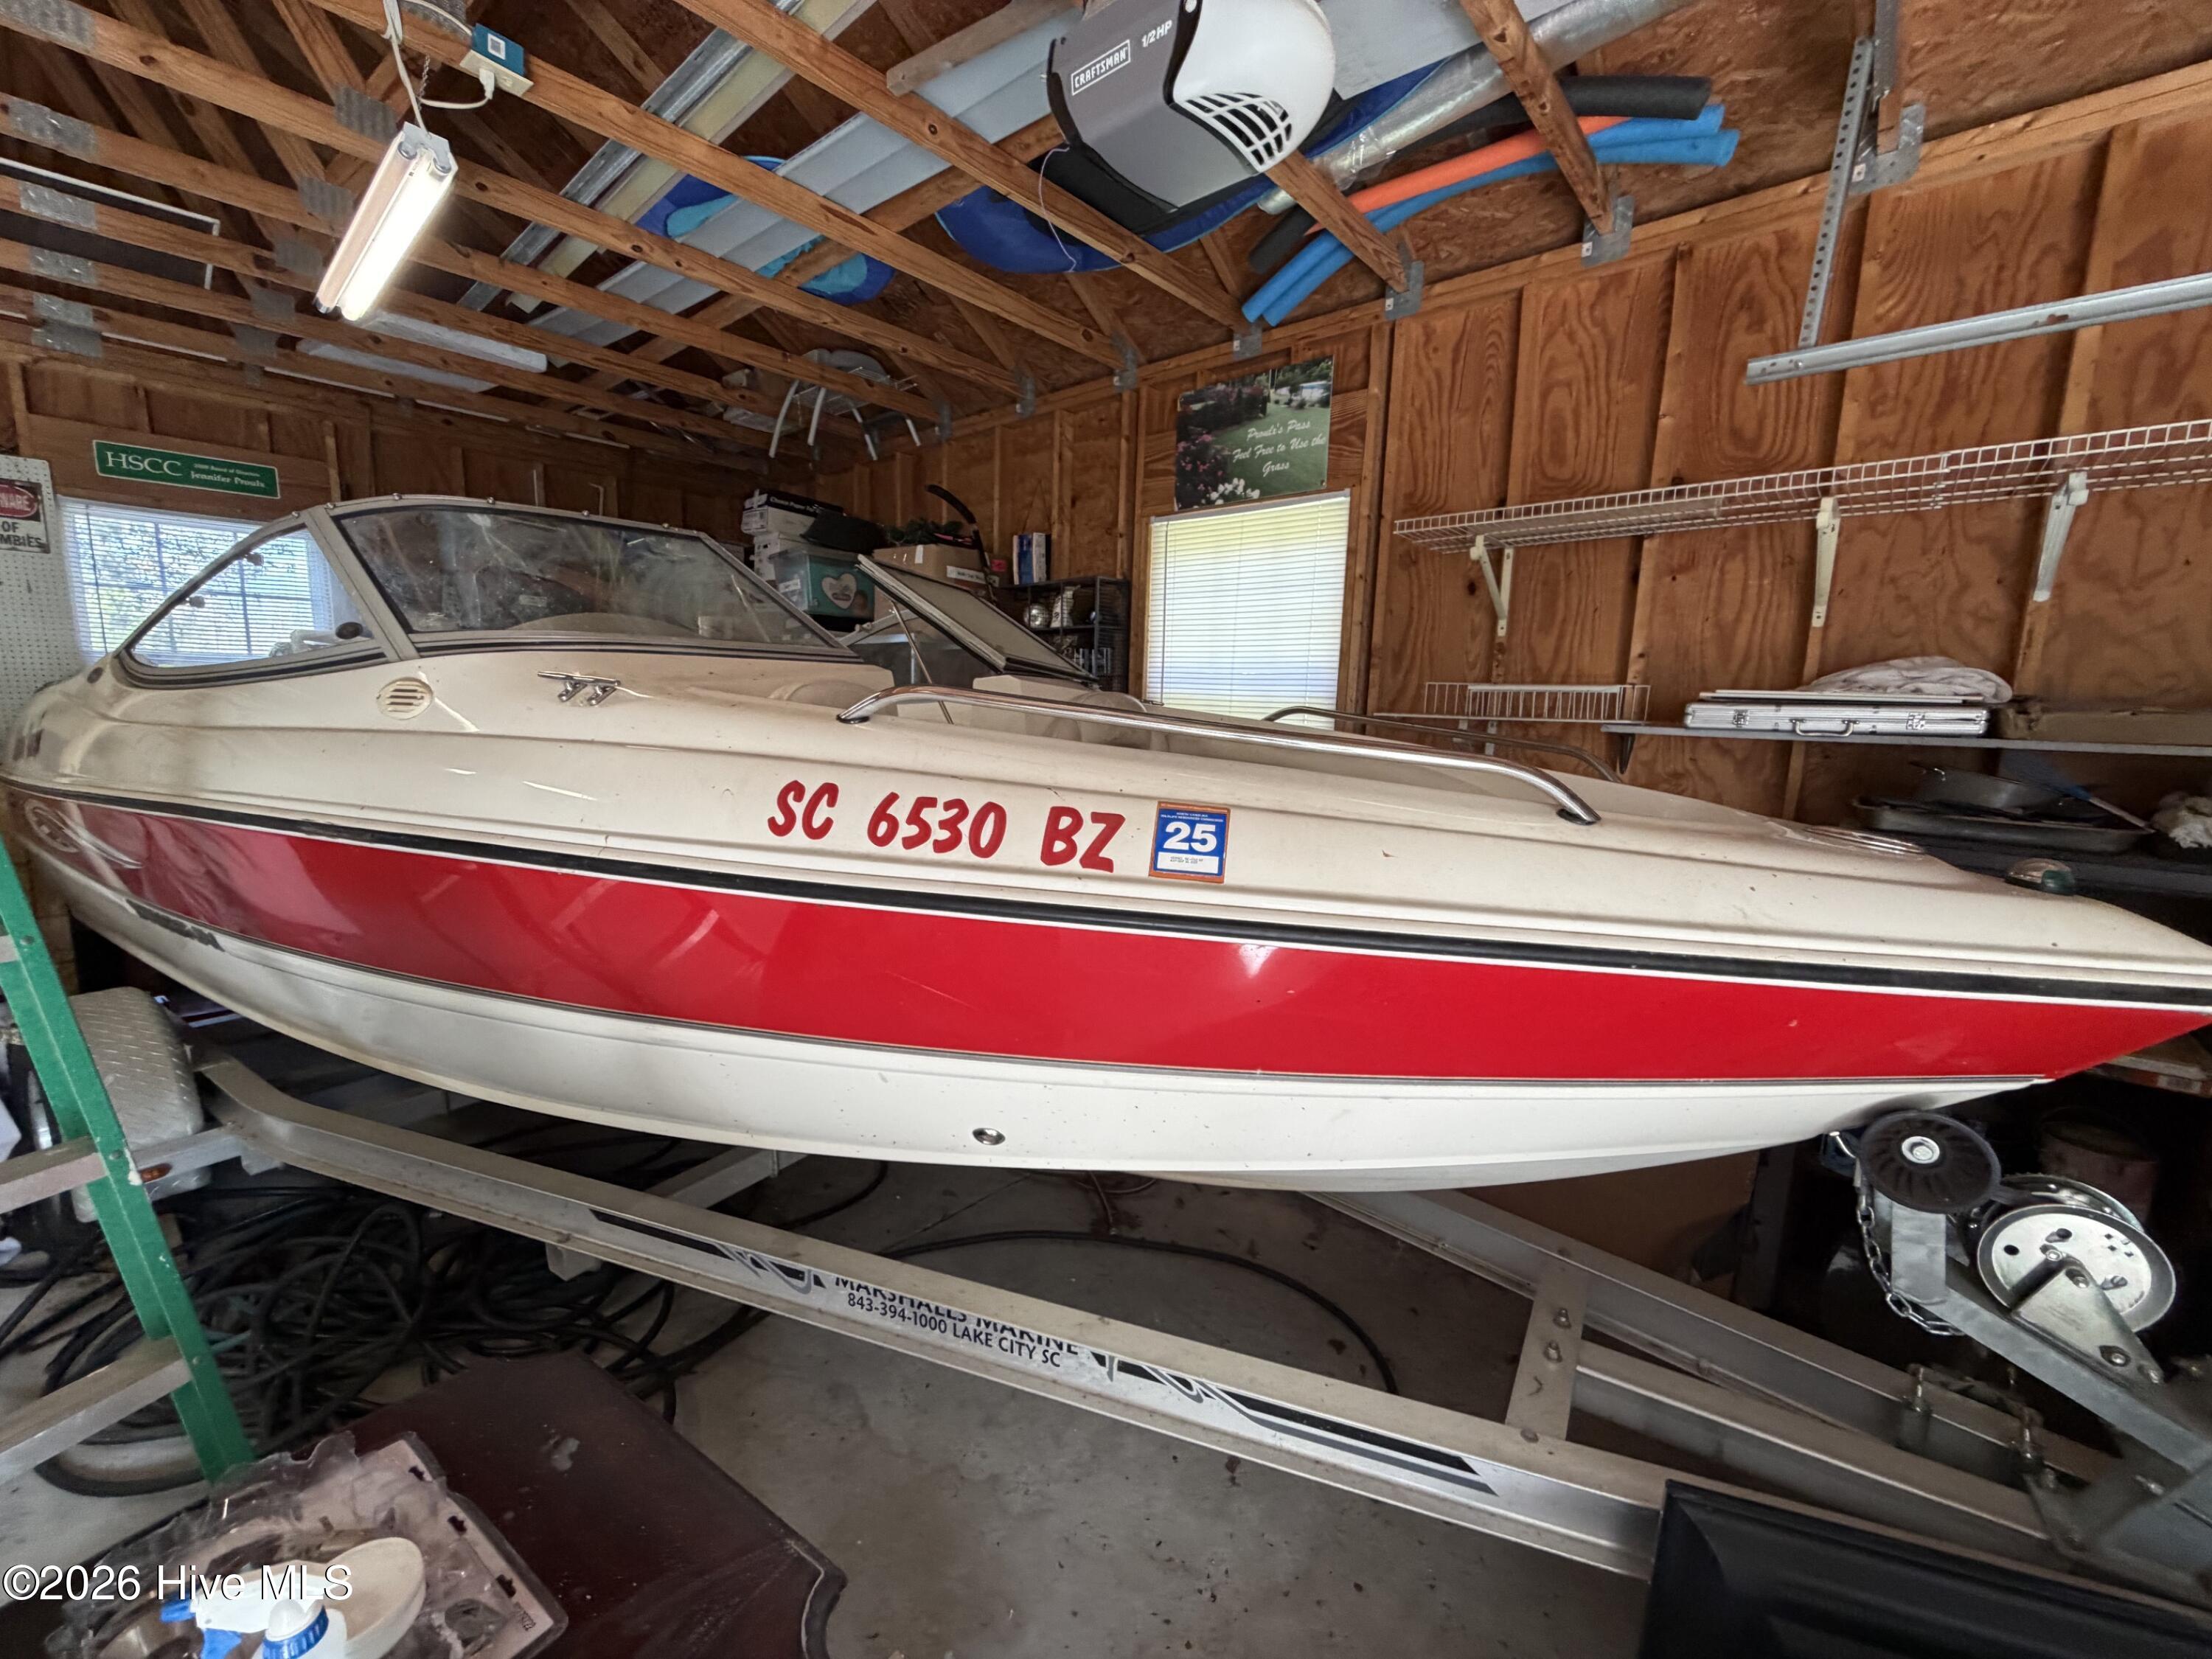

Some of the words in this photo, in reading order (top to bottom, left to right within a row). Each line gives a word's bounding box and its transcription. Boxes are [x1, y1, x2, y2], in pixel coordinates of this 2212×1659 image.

[1074, 47, 1127, 88] CRAFTSMAN
[1287, 420, 1310, 434] Pass
[1232, 447, 1252, 463] Feel
[1254, 444, 1274, 459] Free
[1276, 443, 1286, 453] to
[1290, 437, 1309, 450] Use
[1311, 433, 1326, 446] the
[105, 451, 183, 476] HSCC
[191, 470, 231, 483] Jennifer
[1262, 460, 1290, 477] Grass
[2, 521, 19, 532] OF
[768, 779, 839, 841] SC
[867, 792, 1007, 859] 6530
[1040, 806, 1126, 874] BZ
[1163, 821, 1217, 852] 25
[848, 1293, 947, 1334] 843-394-1000
[953, 1323, 993, 1348] LAKE
[998, 1337, 1036, 1360] CITY
[1042, 1349, 1060, 1368] SC
